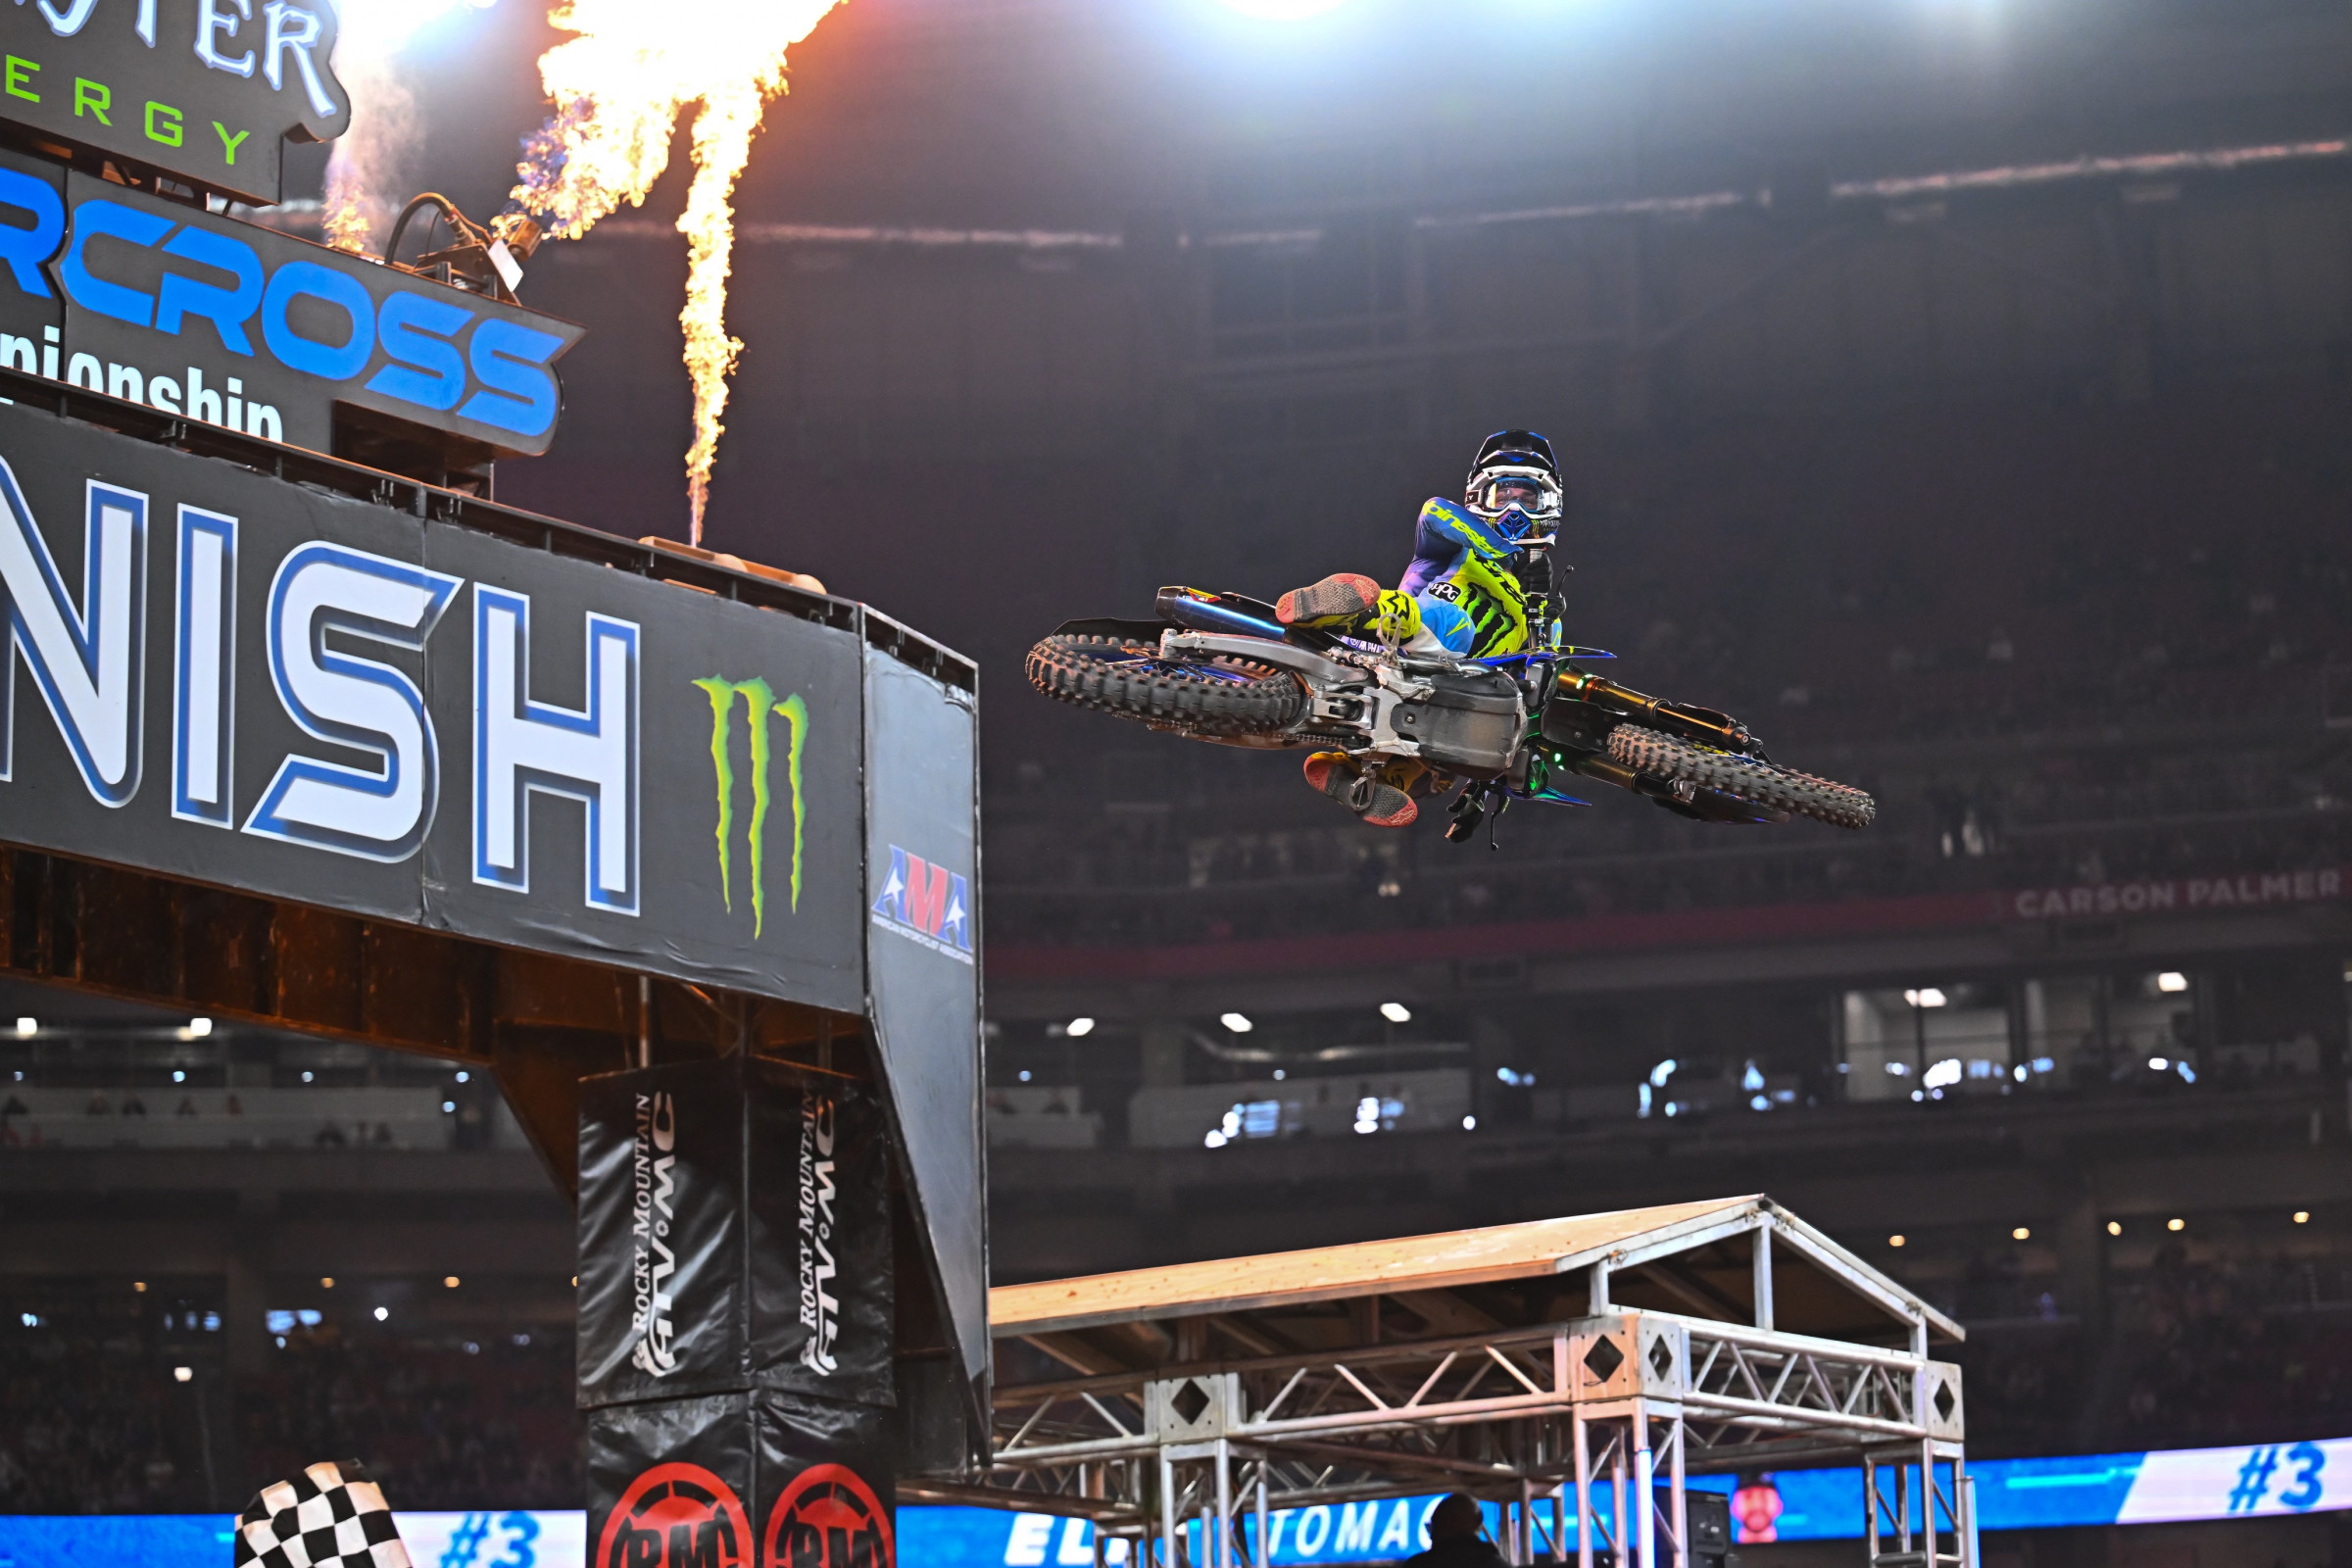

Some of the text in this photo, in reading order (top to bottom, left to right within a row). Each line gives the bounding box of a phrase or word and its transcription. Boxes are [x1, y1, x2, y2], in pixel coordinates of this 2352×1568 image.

[871, 843, 973, 953] AMA
[2016, 869, 2340, 917] CARSON PALMER
[631, 1092, 652, 1334] ROCKY MOUNTAIN
[799, 1091, 818, 1331] ROCKY MOUNTAIN
[2227, 1441, 2326, 1514] #3
[439, 1510, 540, 1568] #3
